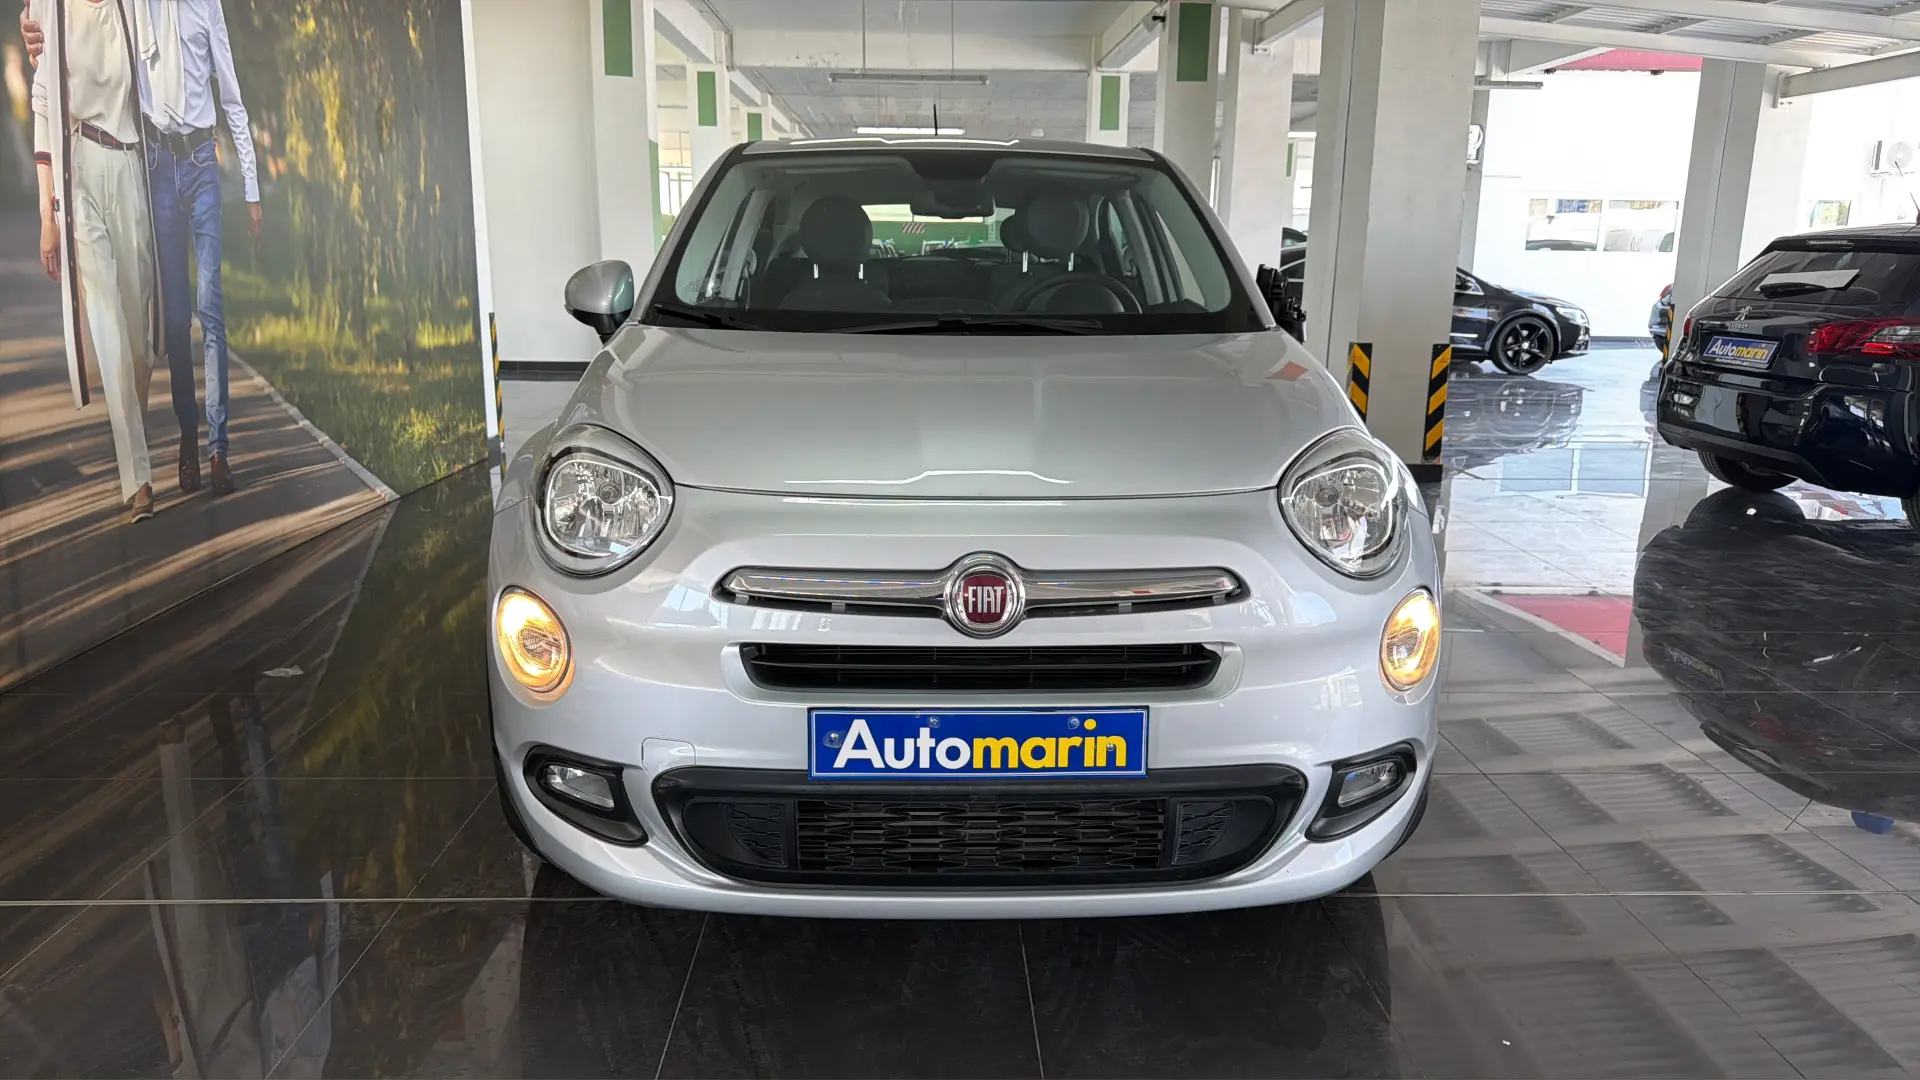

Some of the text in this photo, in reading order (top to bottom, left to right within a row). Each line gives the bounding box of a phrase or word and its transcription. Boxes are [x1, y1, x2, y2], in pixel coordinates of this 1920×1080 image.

[1708, 338, 1769, 360] Automarin
[967, 585, 1005, 614] FIAT
[832, 718, 1127, 770] Automarin
